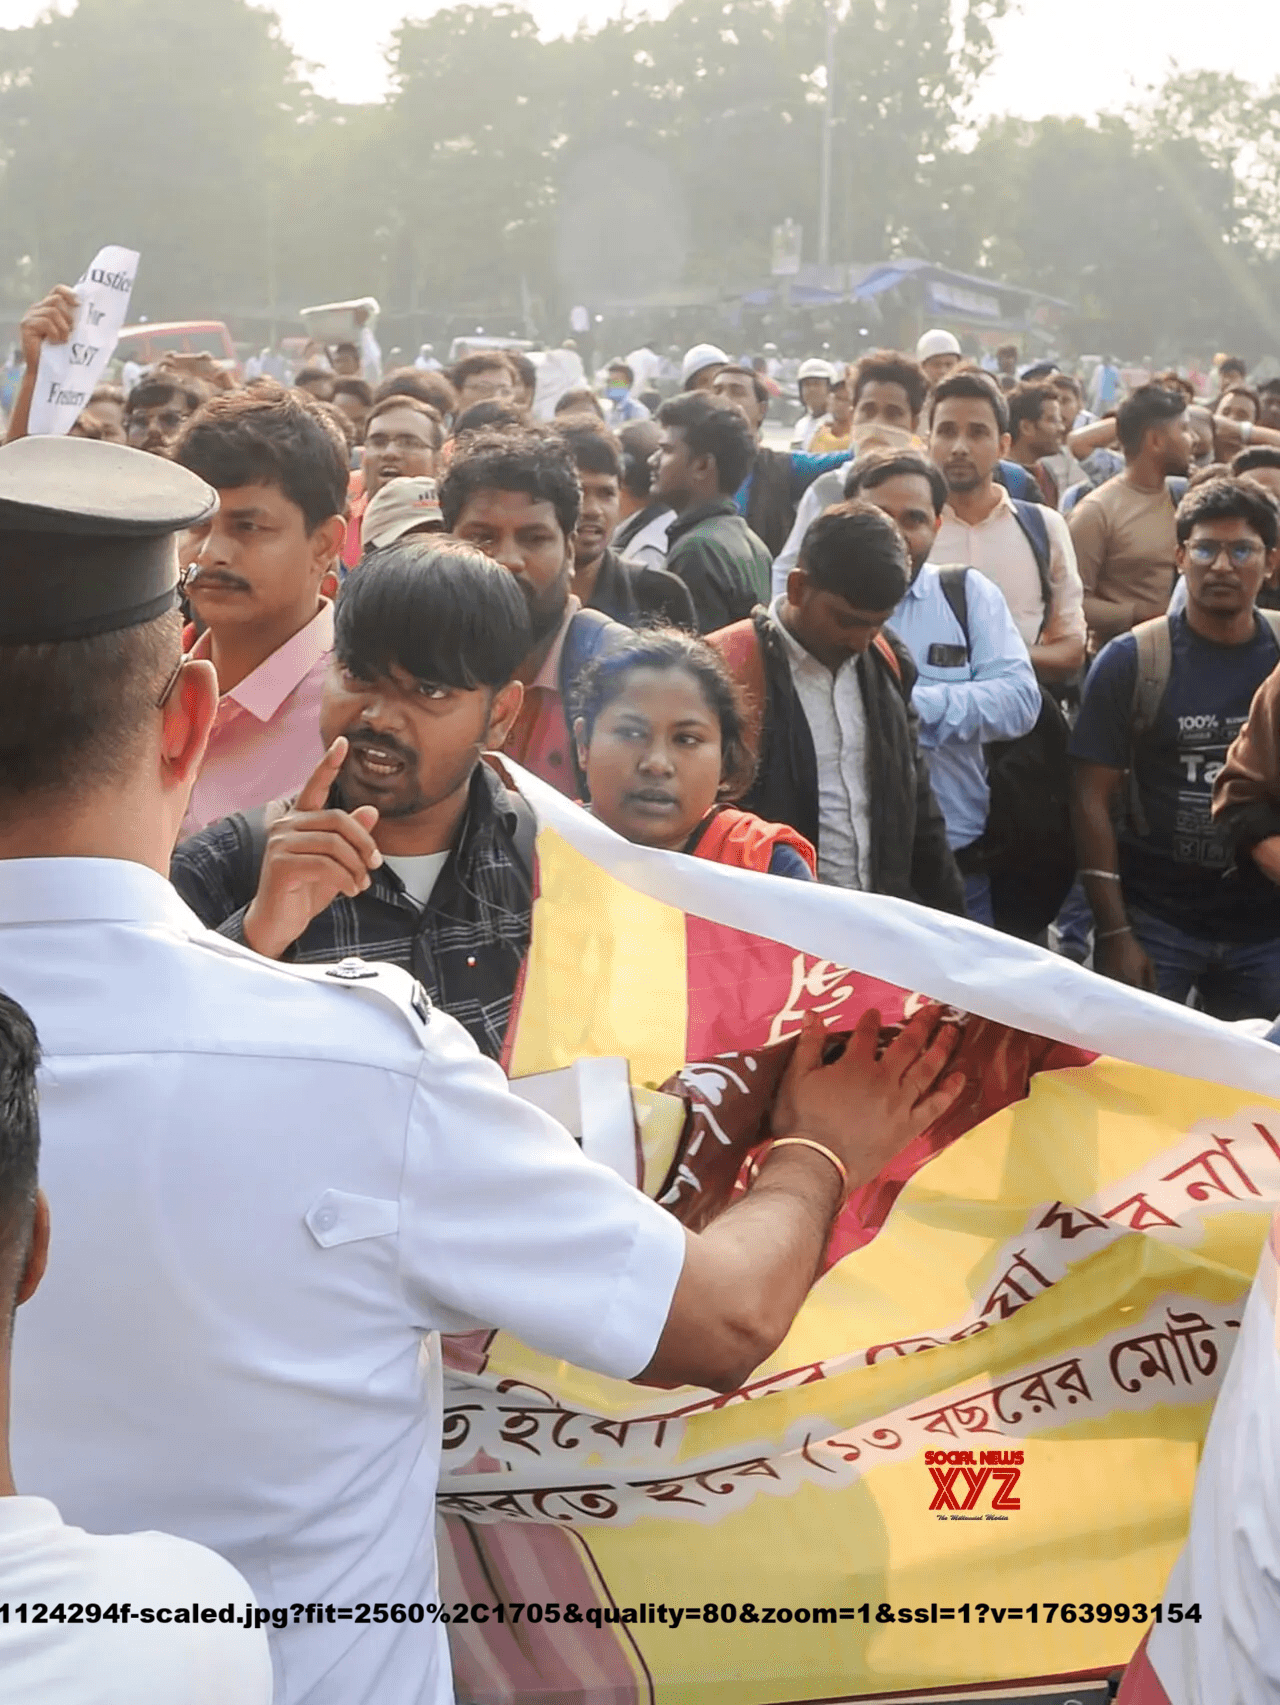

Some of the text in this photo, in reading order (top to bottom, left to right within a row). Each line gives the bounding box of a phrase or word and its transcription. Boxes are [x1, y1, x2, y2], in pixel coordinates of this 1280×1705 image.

[1178, 714, 1219, 730] 100%
[626, 1456, 782, 1507] হবে
[907, 1357, 1093, 1439] বছরের
[1109, 1306, 1219, 1393] মোট
